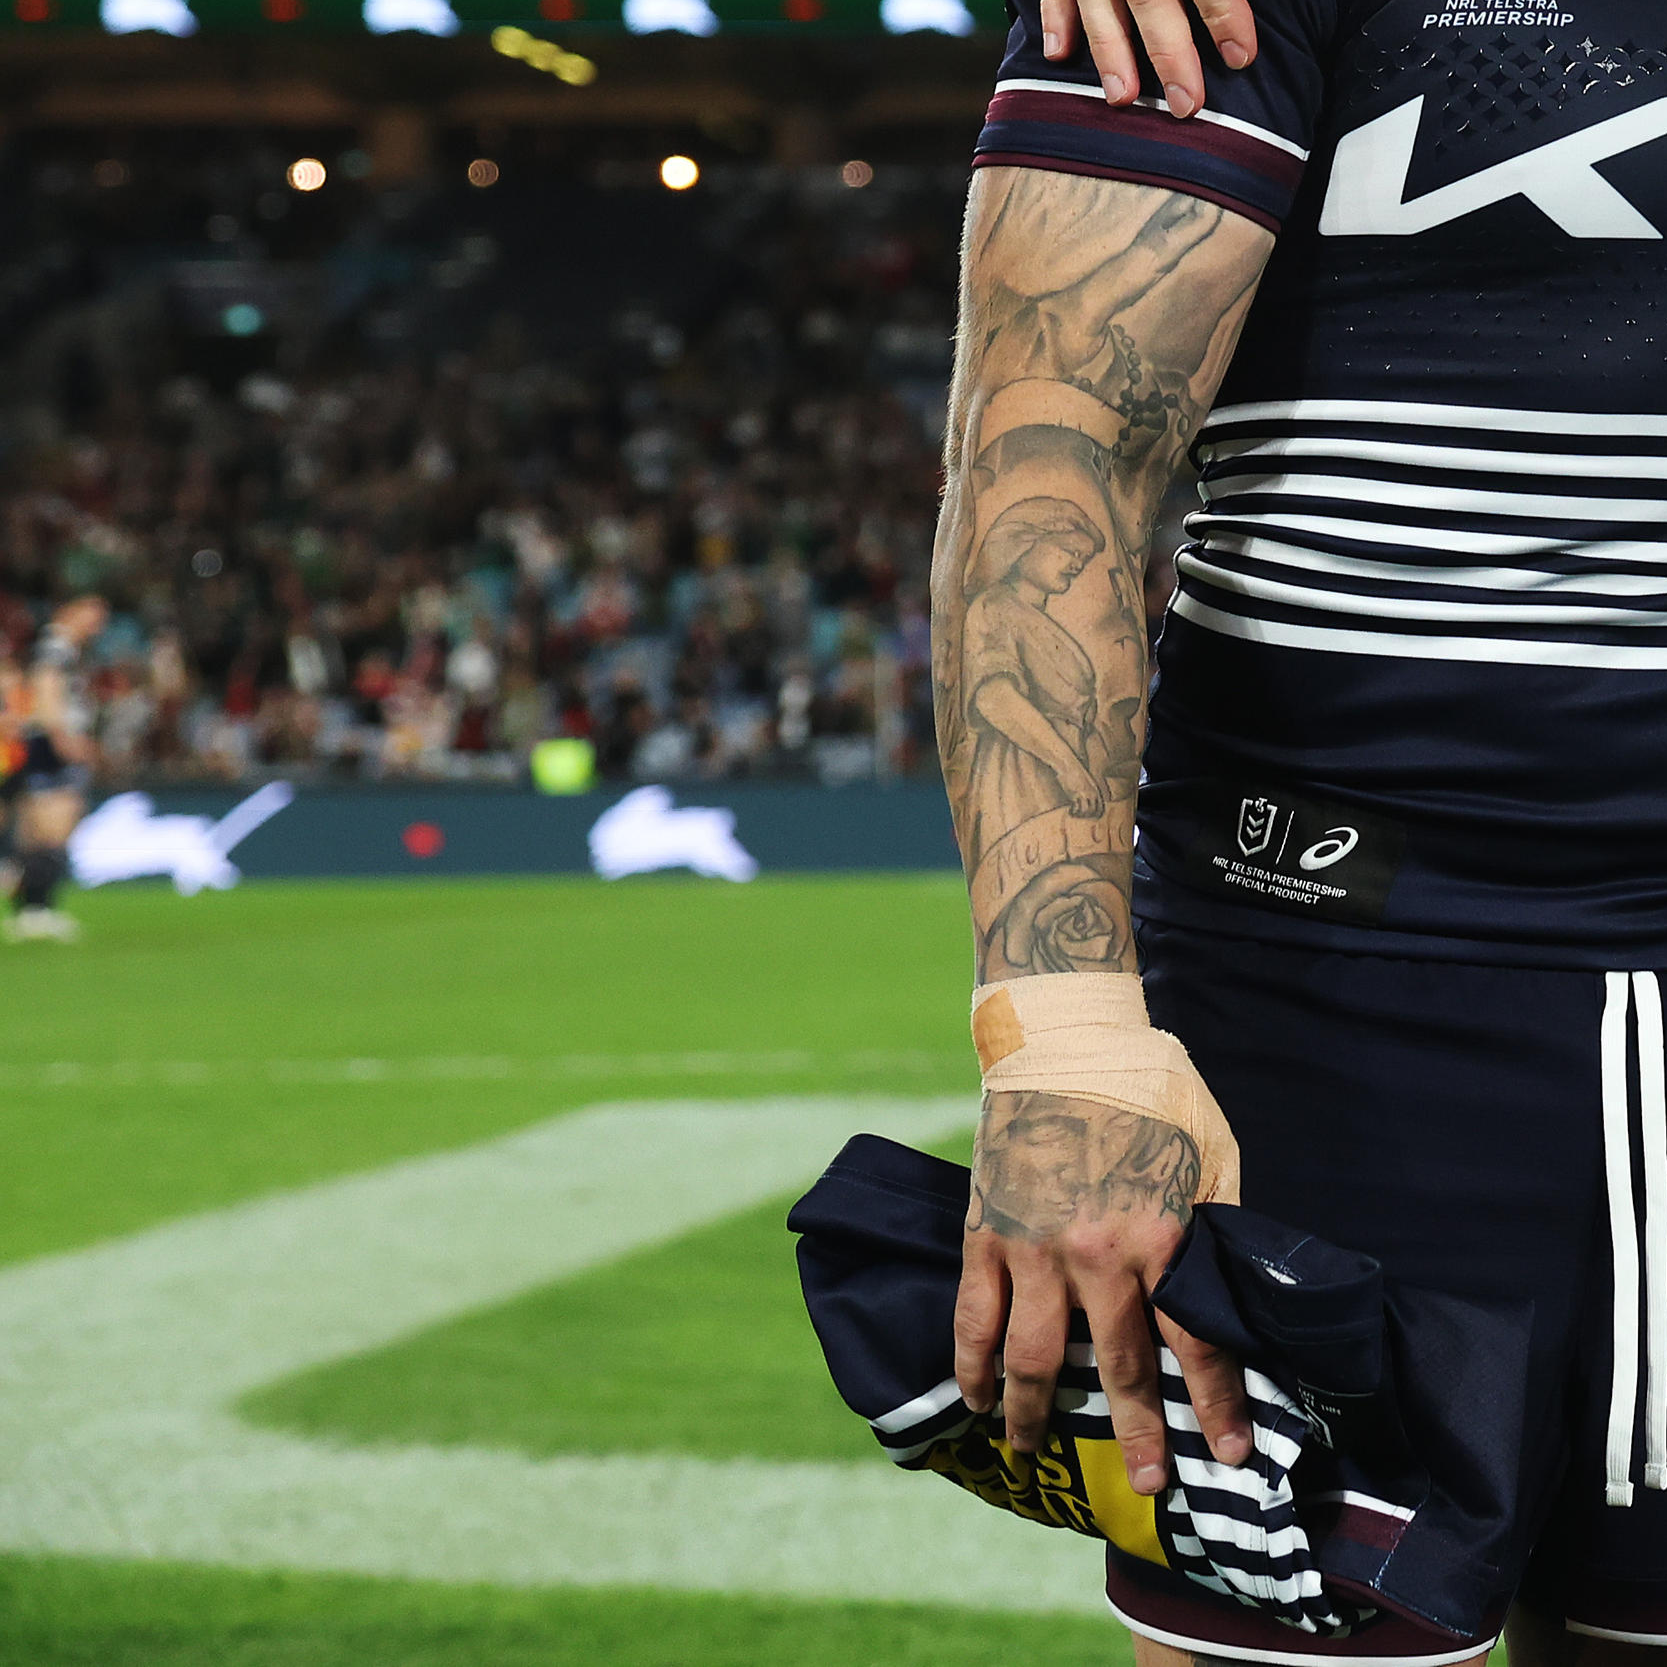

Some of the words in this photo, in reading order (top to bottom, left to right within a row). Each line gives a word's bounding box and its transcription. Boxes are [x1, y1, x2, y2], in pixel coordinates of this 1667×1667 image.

[1422, 10, 1575, 29] PREMIERSHIP
[1212, 855, 1229, 870] NRL
[1230, 861, 1271, 882] TELSTRA
[1271, 872, 1348, 899] PREMIERSHIP
[1224, 872, 1267, 893] OFFICIAL
[1267, 884, 1321, 905] PRODUCT
